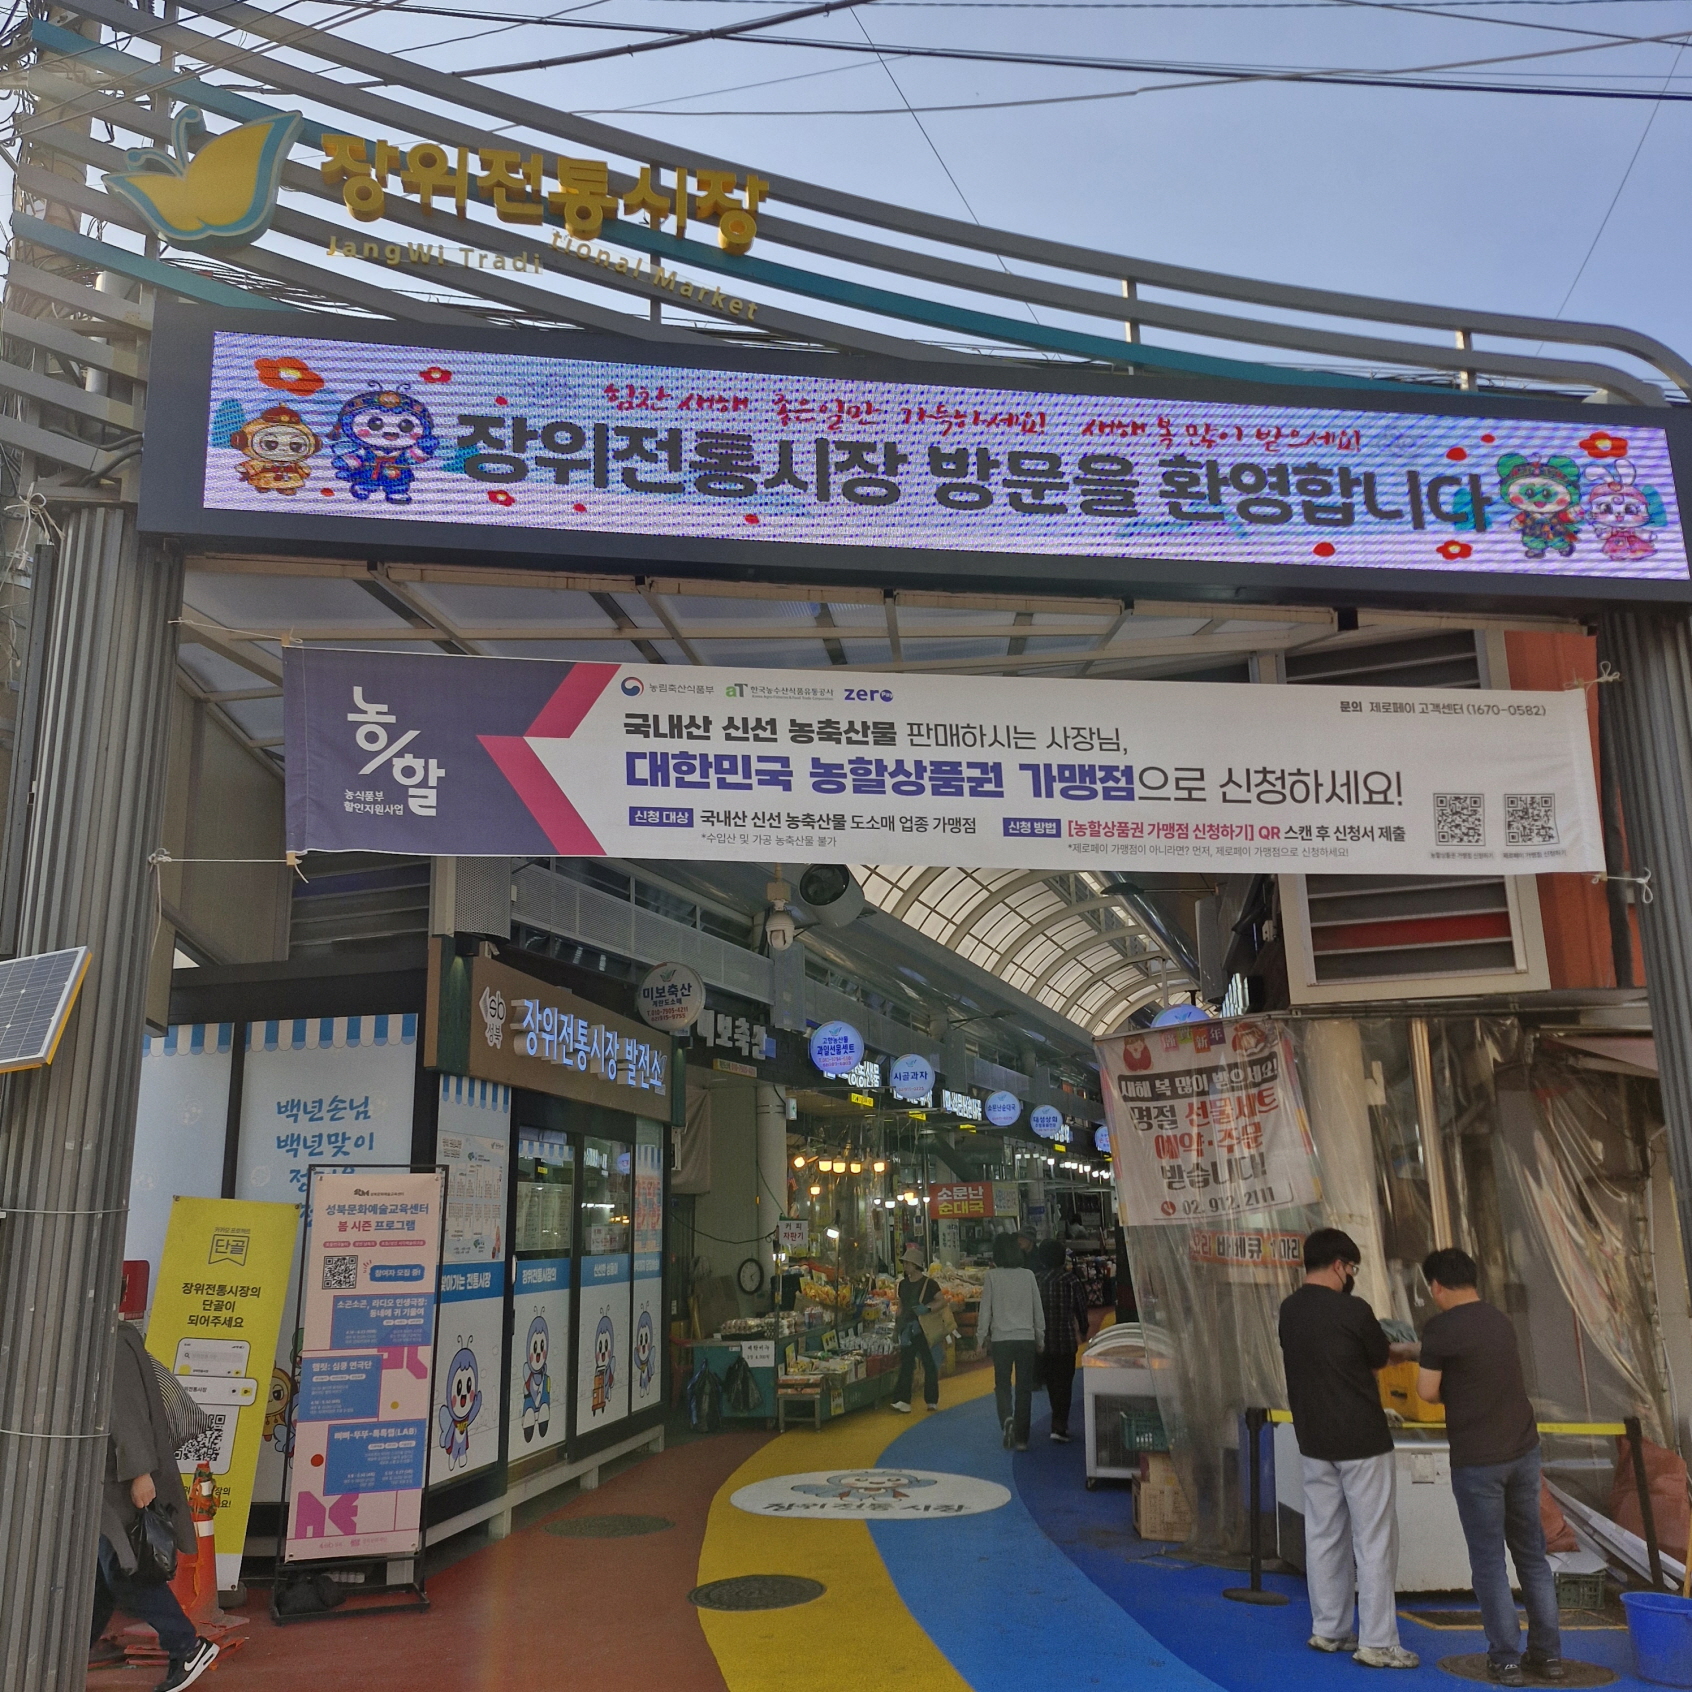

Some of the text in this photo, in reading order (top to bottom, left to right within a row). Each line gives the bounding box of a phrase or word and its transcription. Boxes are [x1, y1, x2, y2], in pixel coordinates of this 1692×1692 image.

[321, 134, 768, 256] 장위전통시장
[328, 235, 445, 267] JangWi
[653, 265, 758, 322] Market
[604, 383, 672, 411] 힘찬
[678, 393, 749, 411] 새해
[903, 405, 1046, 435] 가득하세요!
[1081, 416, 1146, 437] 새해
[1157, 416, 1174, 448] 복
[1186, 424, 1242, 447] 많이
[1256, 429, 1360, 451] 받으세요!
[456, 415, 1492, 533] 장위전통시장 방문을 환영합니다
[649, 683, 714, 694] 농림축산식품부
[726, 683, 748, 697] aT
[751, 686, 834, 696] 한국농수산식품유통공사
[1340, 701, 1546, 716] 문의 제로페이 고객센터 (1670-0582)
[624, 713, 1128, 755] 국내산 신선 농축산물 판매하시는 사장님,
[626, 751, 1403, 806] 대한민국 농할상품권 가맹점으로 신청하세요!
[345, 789, 384, 801] 농식품부
[344, 801, 403, 815] 할인지원사업
[635, 811, 689, 824] 신청 대상
[700, 810, 976, 834] 국내산 신선 농축산물 도소매 업종 가맹점
[1008, 821, 1056, 834] 신청 방법
[1068, 820, 1406, 842] [농할상품권 가맹점 신청하기] QR 스캔 후 신청서 제출
[739, 835, 749, 845] 및
[753, 835, 772, 846] 가공
[775, 835, 814, 846] 농축산물
[818, 836, 837, 847] 불가
[1111, 844, 1146, 855] 가맹점이
[1149, 845, 1189, 856] 아니라면?
[1192, 845, 1213, 857] 먼저,
[1215, 846, 1251, 857] 제로페이
[1254, 846, 1298, 858] 가맹점으로
[1302, 847, 1349, 857] 신청하세요!
[643, 983, 692, 1000] 미보축산
[487, 1023, 502, 1049] 성북
[521, 998, 663, 1090] 장위전통시장 발전소
[817, 1044, 855, 1056] 과일선물셋트
[894, 1071, 928, 1081] 시골과자
[1121, 1079, 1151, 1098] 새해
[1155, 1077, 1172, 1098] 복
[1175, 1074, 1208, 1094] 많이
[276, 1095, 371, 1123] 백년손님
[1129, 1086, 1278, 1131] 명절 선물세트
[276, 1132, 374, 1158] 백년맞이
[1161, 1152, 1267, 1190] 받습니다!
[937, 1186, 984, 1200] 소문난
[326, 1203, 429, 1216] 성북문화예술교육센터
[938, 1201, 984, 1215] 순대국
[337, 1220, 416, 1231] 봄 시즌 프로그램
[783, 1232, 803, 1240] 자판기
[215, 1238, 245, 1255] 단골
[466, 1272, 491, 1289] 전통시장
[522, 1267, 557, 1284] 장위전통시장의
[182, 1282, 261, 1298] 장위전통시장의
[202, 1299, 236, 1312] 단골이
[187, 1315, 244, 1328] 되어주세요
